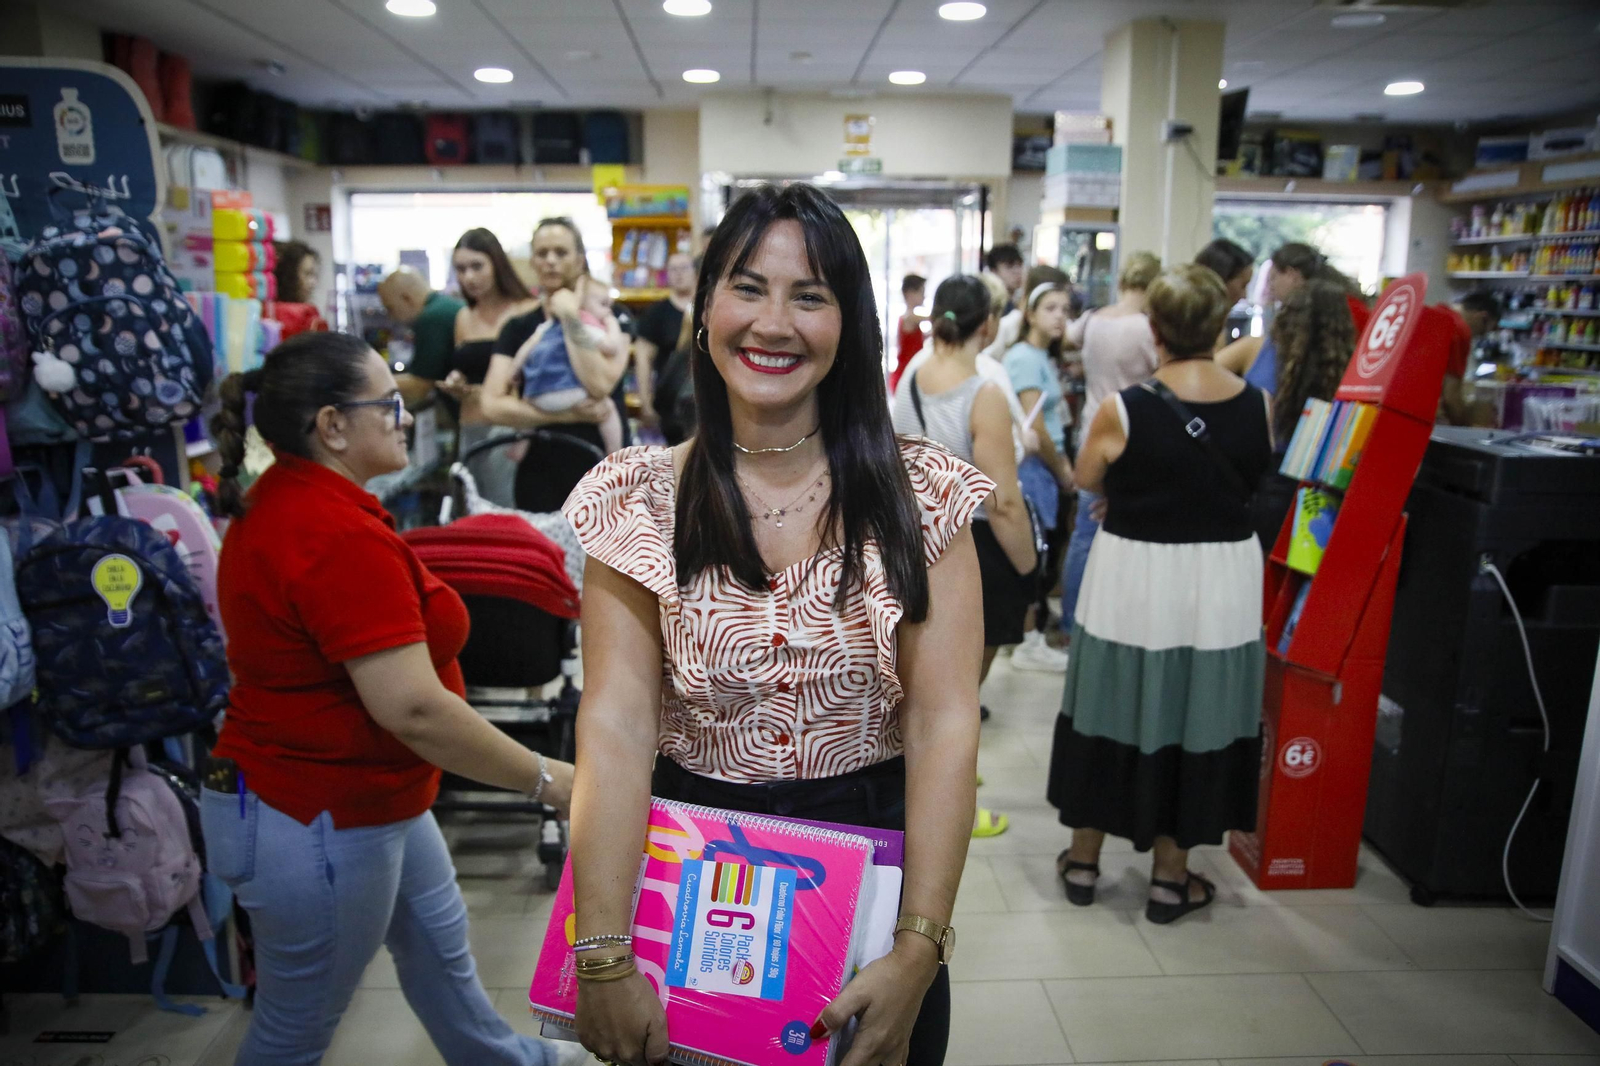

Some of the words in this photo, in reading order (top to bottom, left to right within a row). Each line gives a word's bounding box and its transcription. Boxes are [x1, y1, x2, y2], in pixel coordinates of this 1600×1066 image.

[0, 103, 25, 118] IUS
[777, 882, 789, 909] Cuaderno
[707, 909, 755, 930] 6
[775, 907, 786, 920] Folio
[700, 930, 720, 974] Surtidos
[717, 932, 737, 972] Colores
[771, 946, 781, 961] hojas
